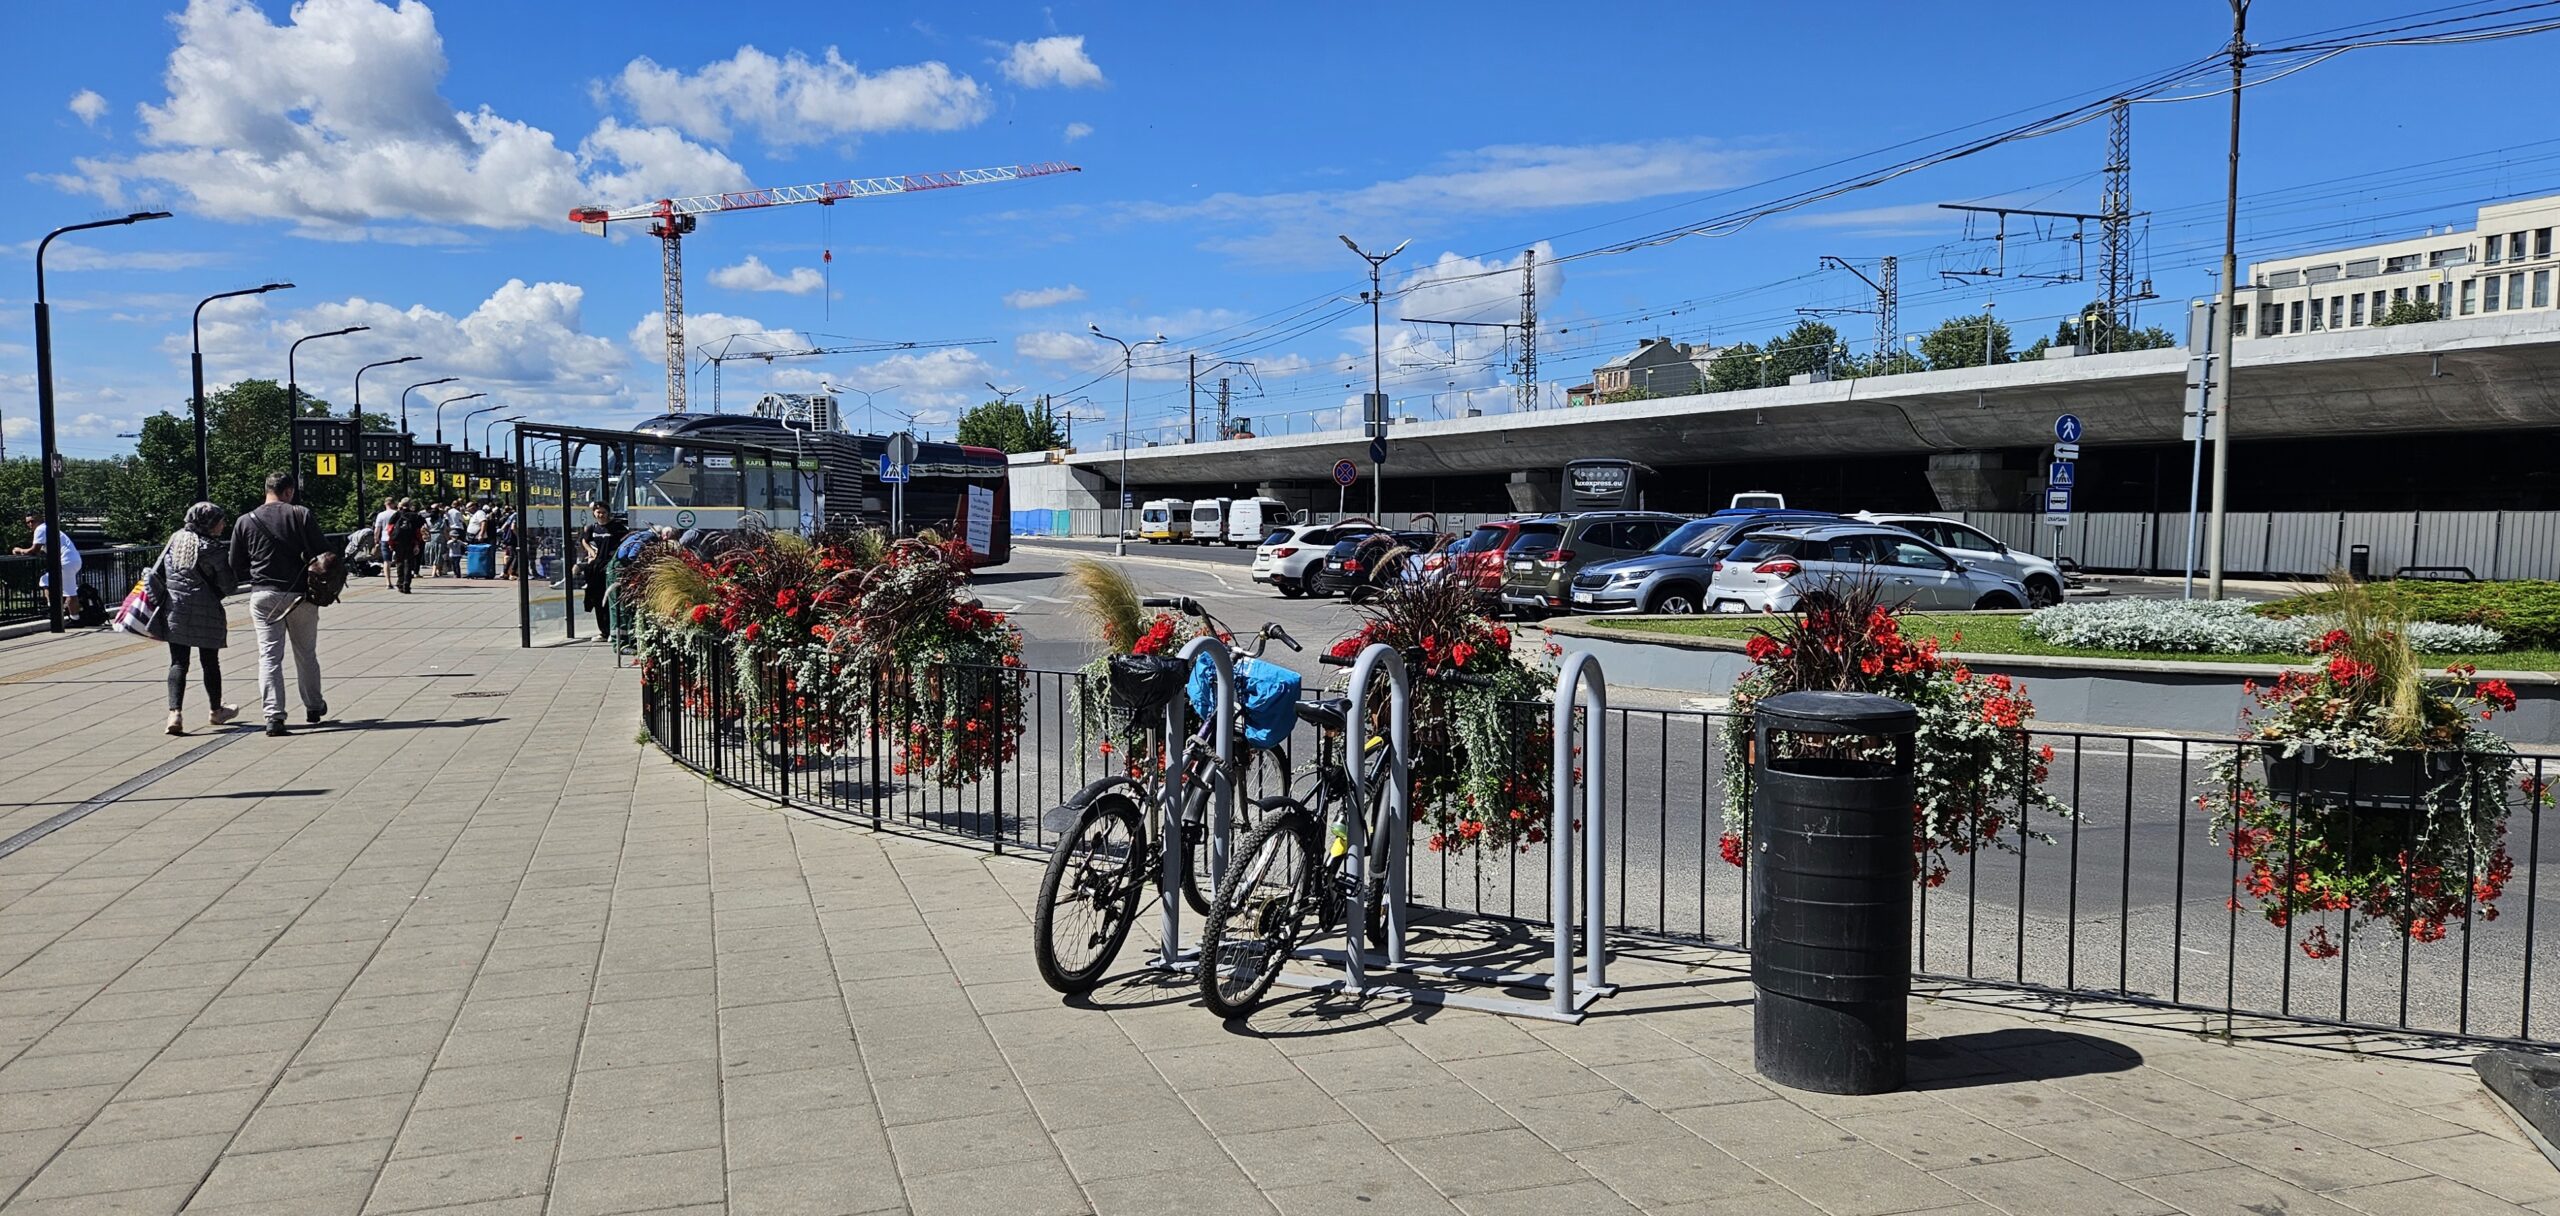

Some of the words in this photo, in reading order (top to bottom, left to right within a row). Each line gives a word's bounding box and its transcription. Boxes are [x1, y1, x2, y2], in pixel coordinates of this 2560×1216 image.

[323, 455, 330, 472] 1
[382, 465, 390, 478] 2
[424, 471, 431, 482] 3
[456, 475, 462, 485] 4
[482, 479, 488, 488] 5
[503, 481, 509, 490] 6
